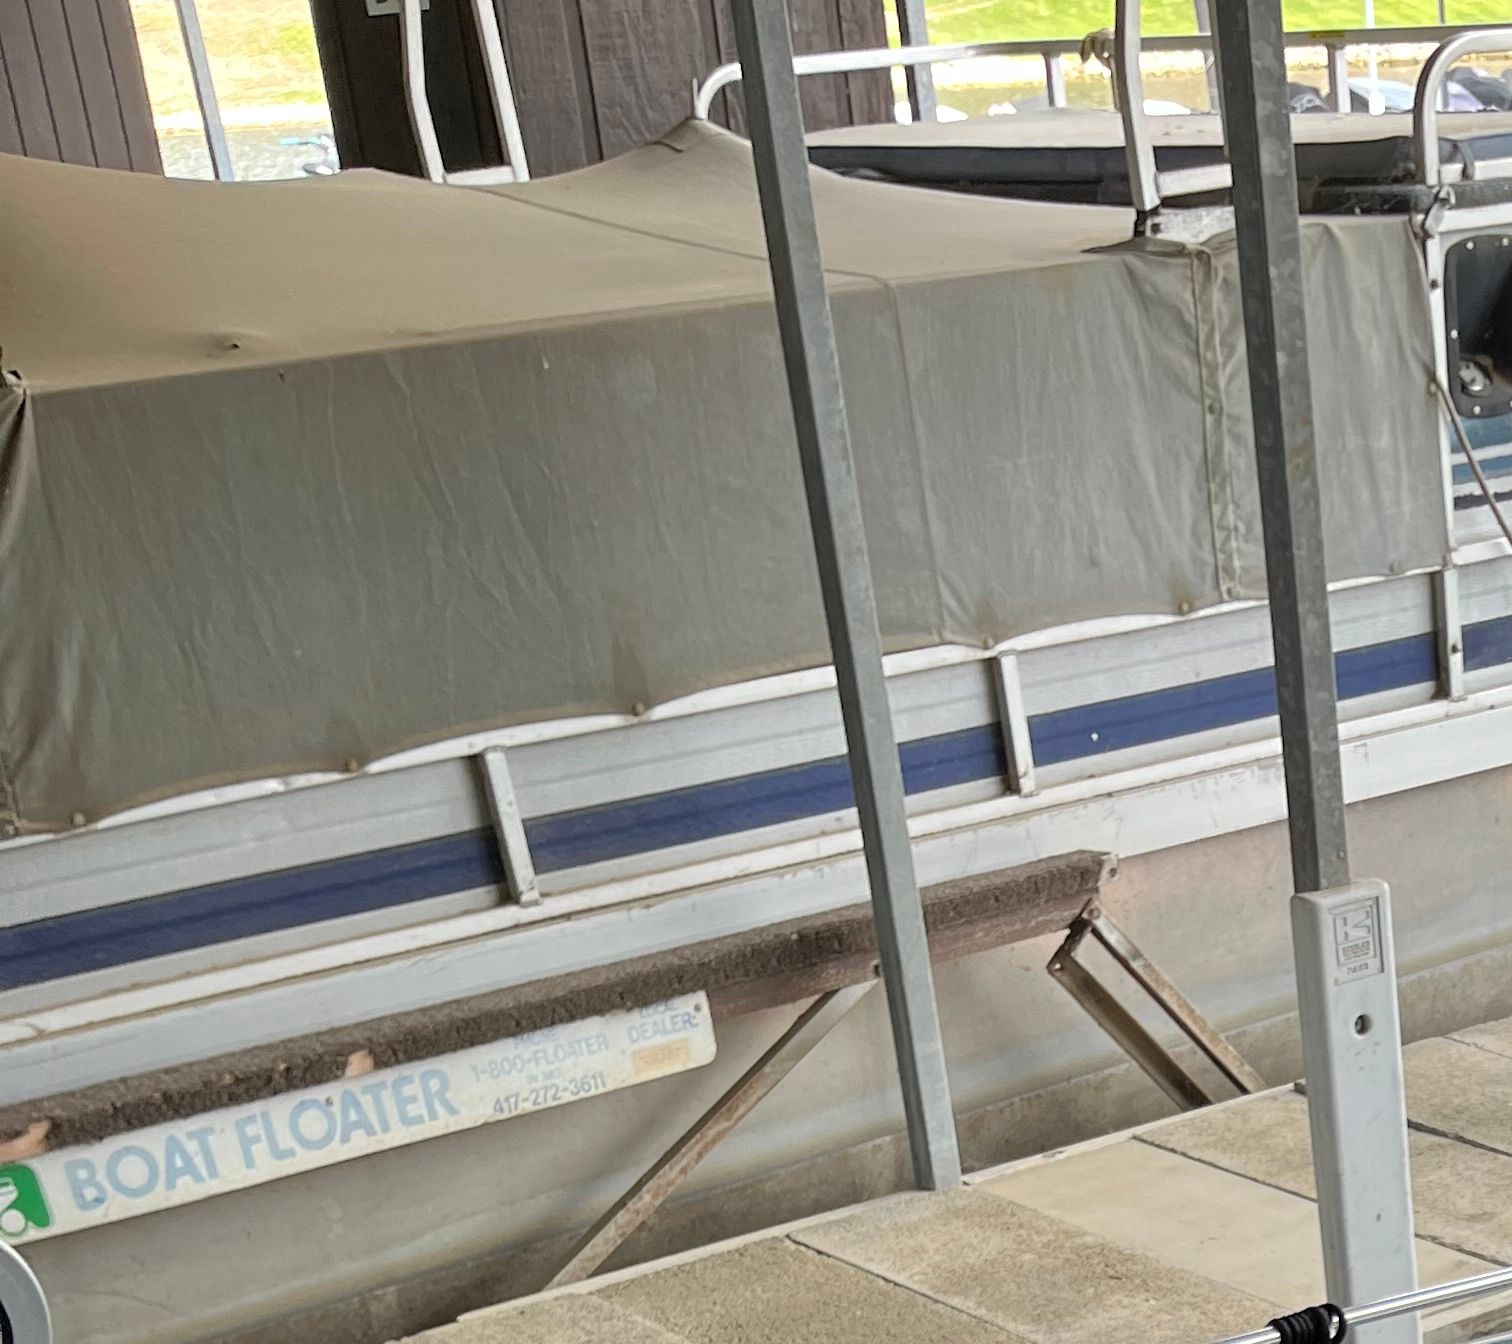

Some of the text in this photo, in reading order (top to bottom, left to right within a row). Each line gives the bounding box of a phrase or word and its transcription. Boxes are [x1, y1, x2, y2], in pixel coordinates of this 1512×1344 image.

[64, 1068, 460, 1213] BOAT FLOATER
[493, 1072, 607, 1116] 417-272-3611
